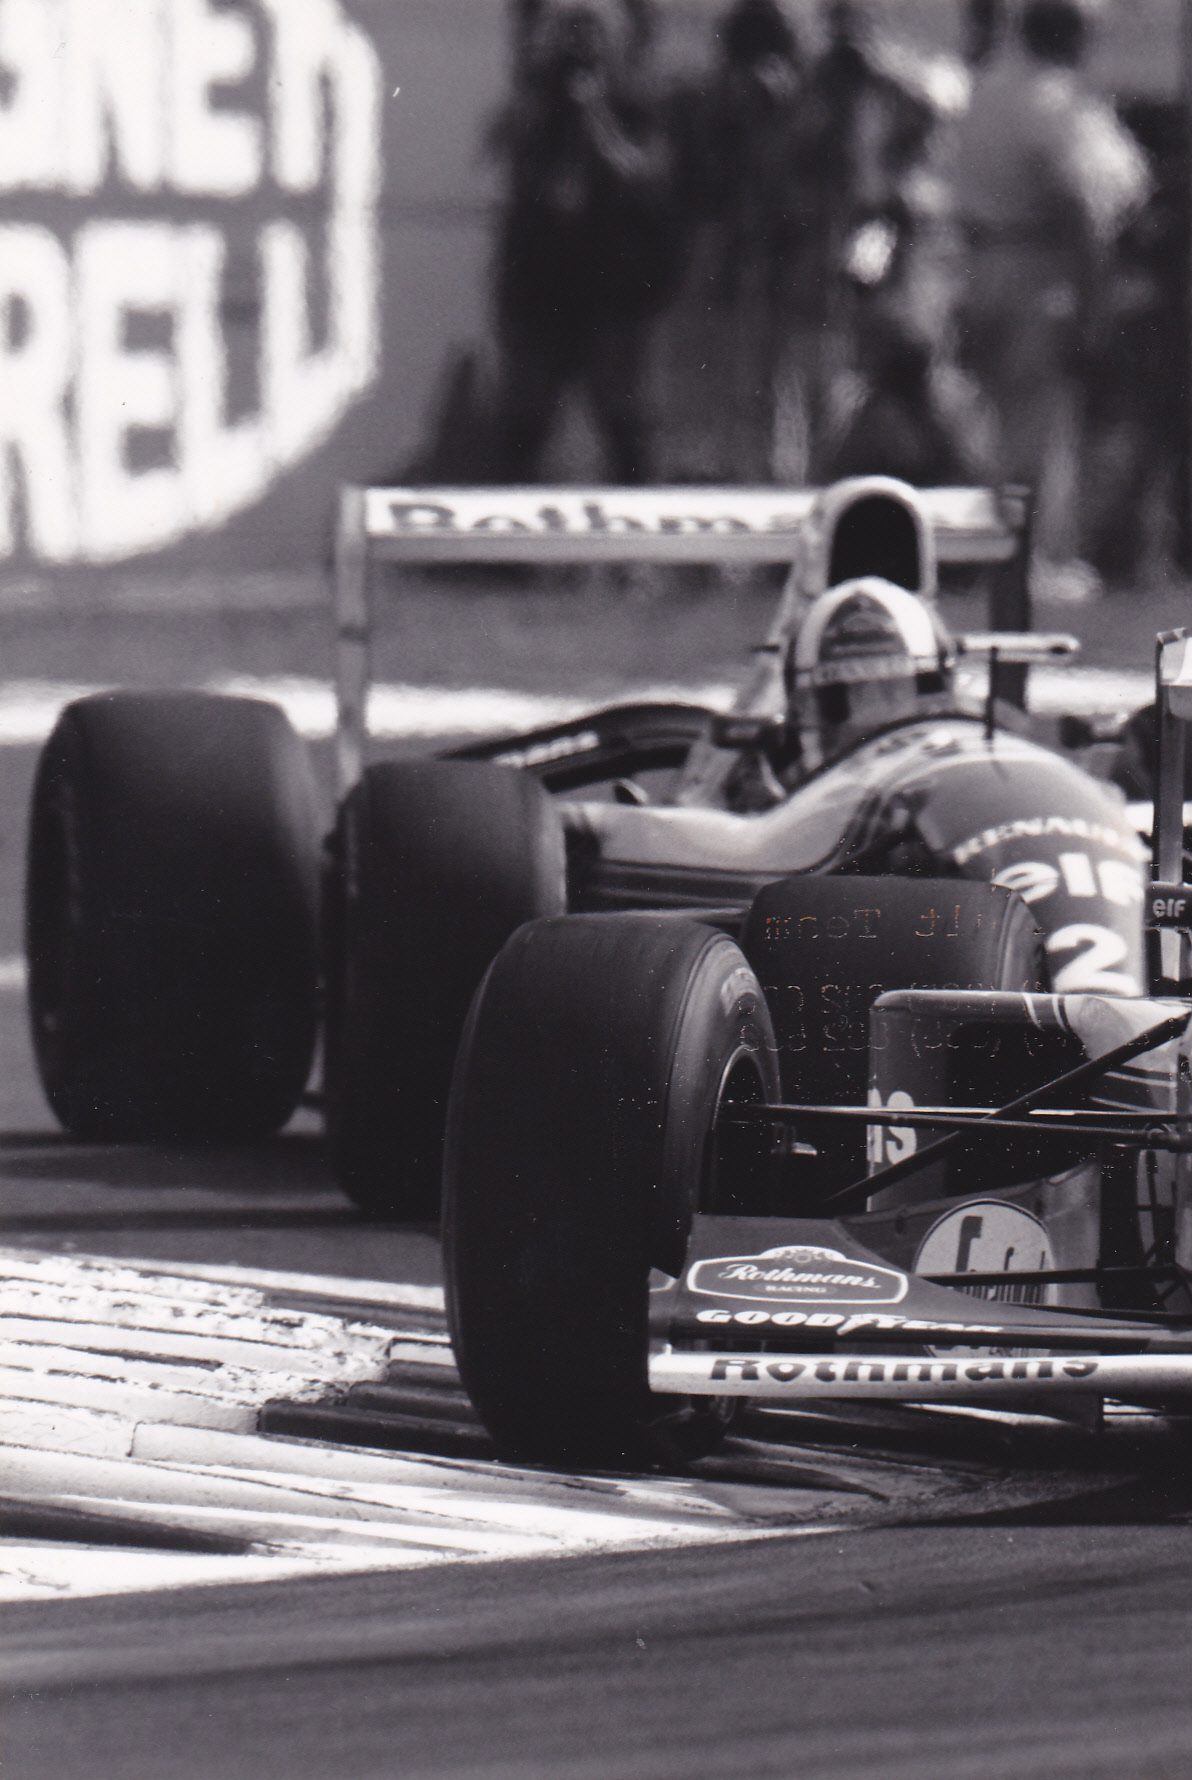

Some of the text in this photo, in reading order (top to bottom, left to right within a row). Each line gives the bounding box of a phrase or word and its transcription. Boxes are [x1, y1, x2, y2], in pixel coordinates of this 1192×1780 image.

[1152, 898, 1187, 918] elf
[1045, 922, 1130, 997] 2
[717, 1262, 883, 1289] Rothmans
[708, 1358, 1099, 1383] Rothmans
